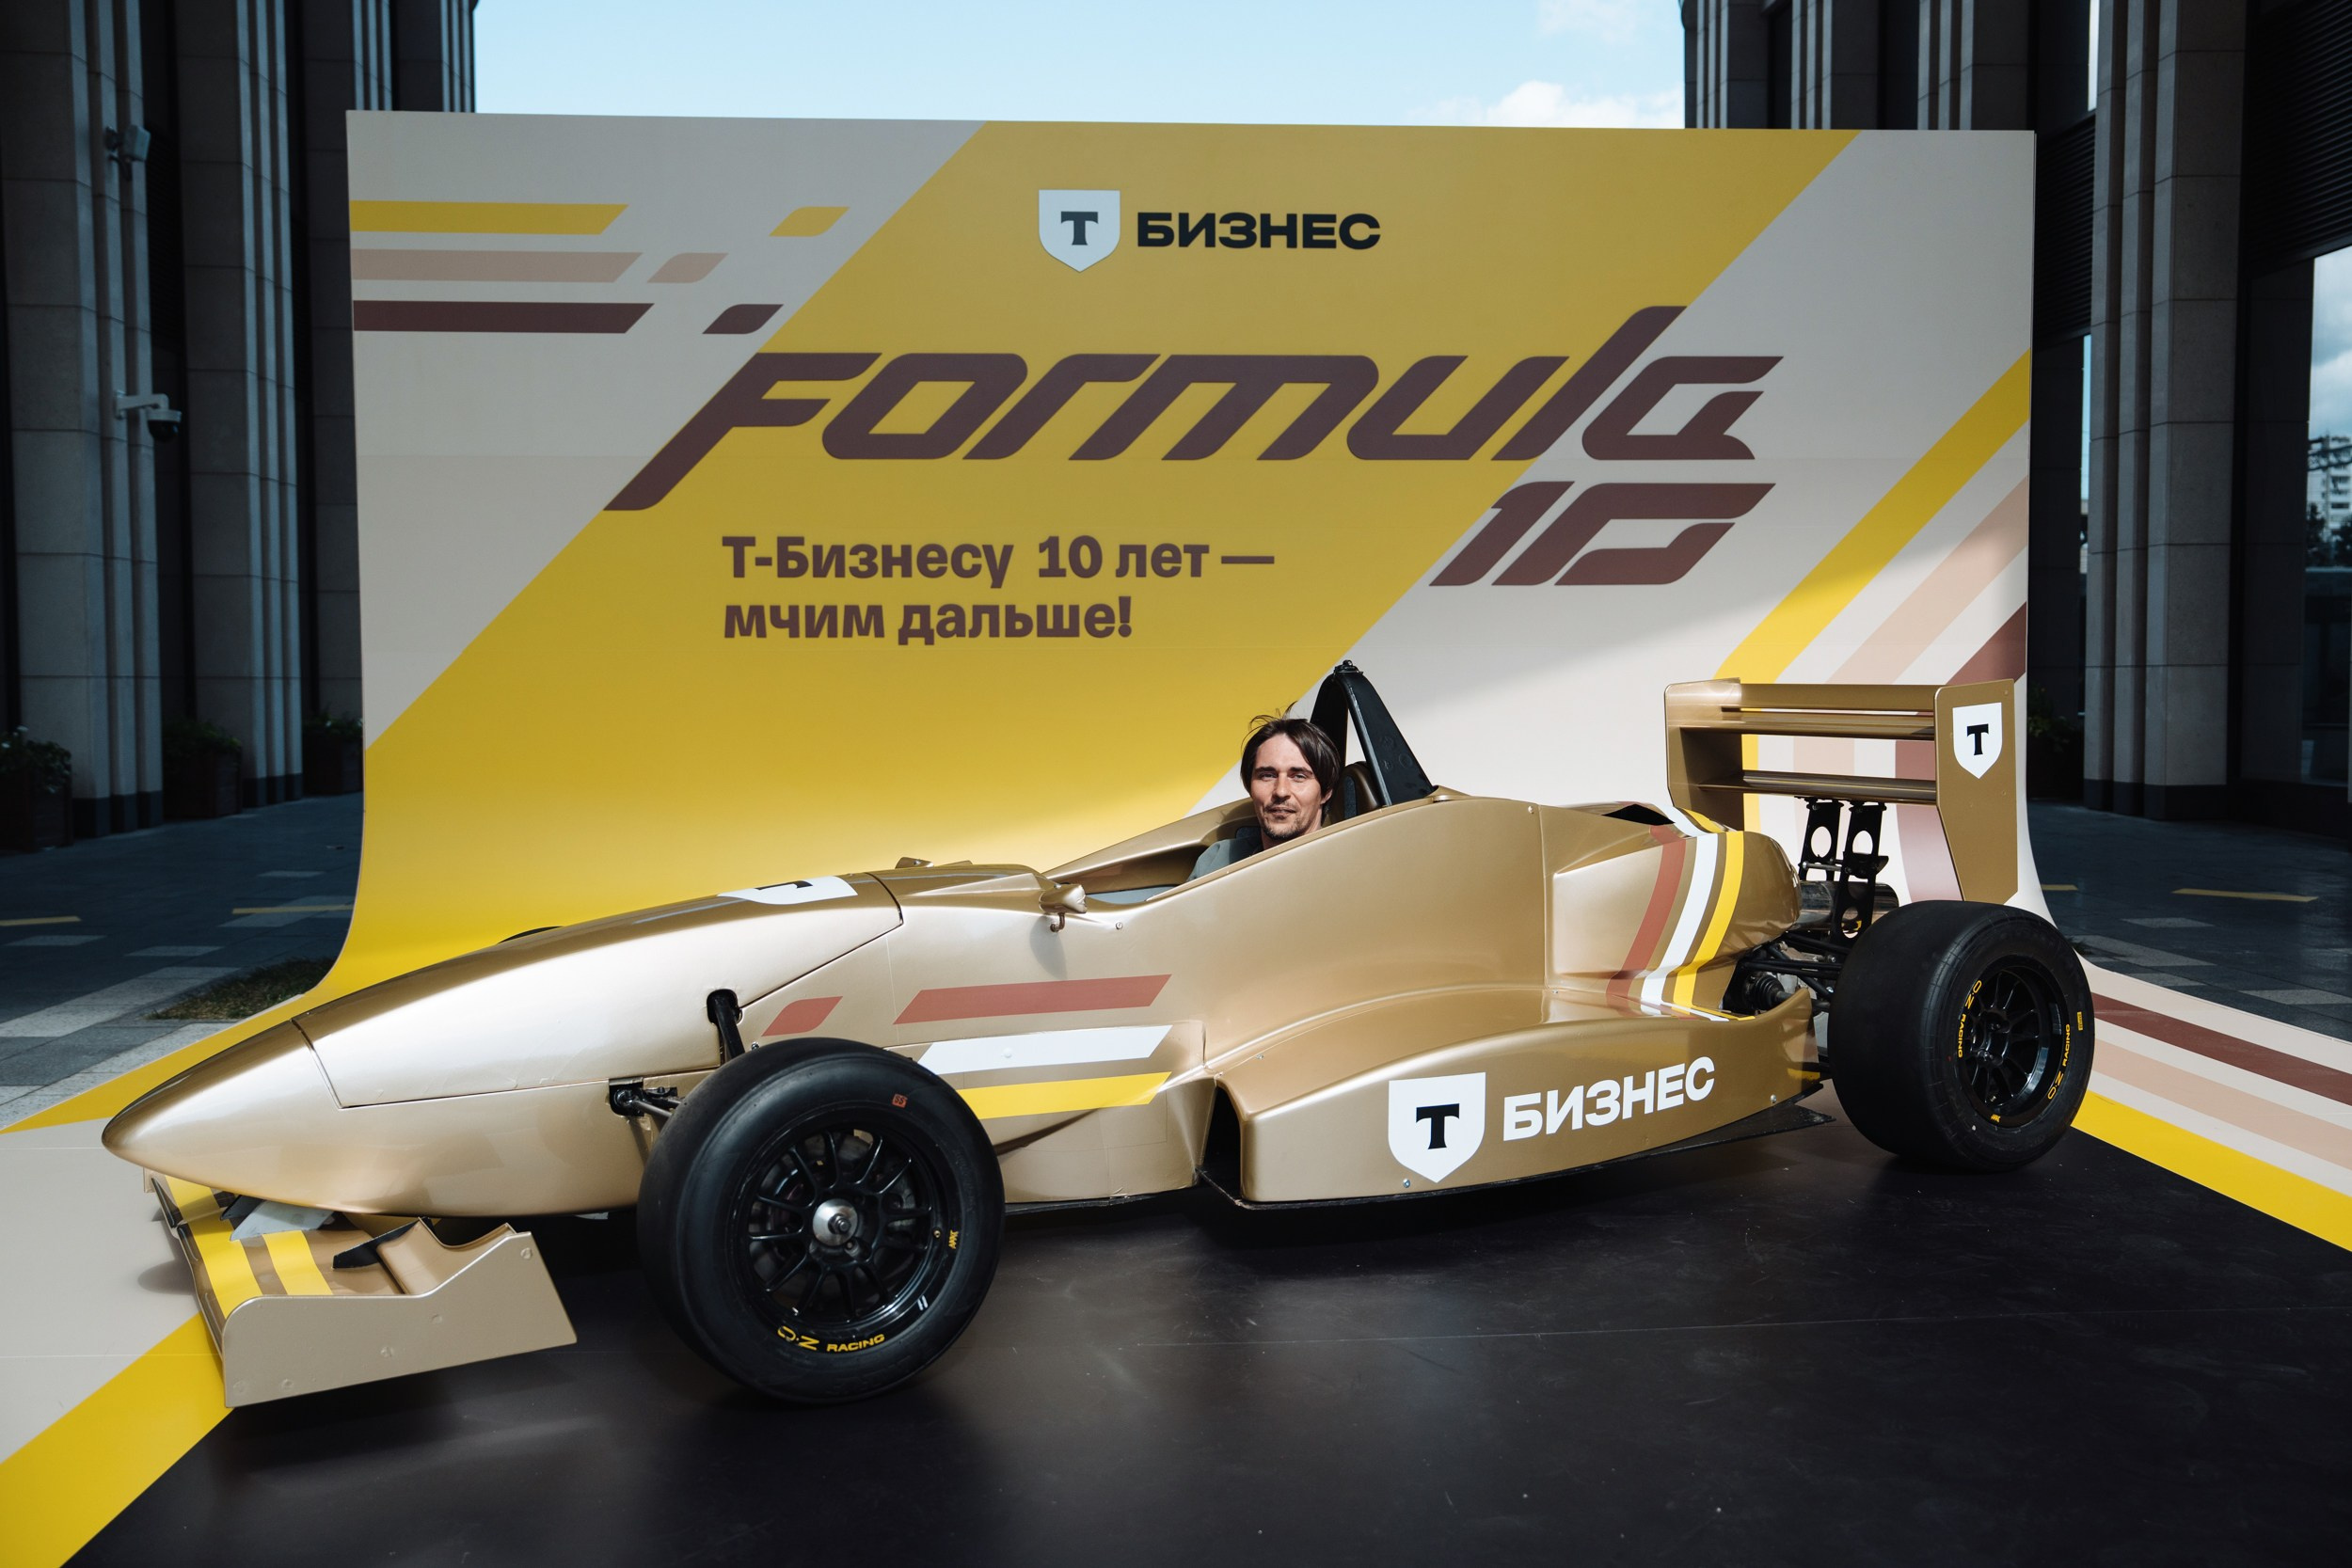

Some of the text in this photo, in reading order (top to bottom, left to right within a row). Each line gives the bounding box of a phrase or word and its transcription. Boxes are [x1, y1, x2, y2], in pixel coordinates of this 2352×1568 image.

[1136, 212, 1381, 250] БИЗНЕС
[602, 305, 1785, 512] Formula
[722, 535, 1014, 589] Т-Бизнесу
[1038, 534, 1104, 579] 10
[1115, 543, 1210, 578] лет
[723, 595, 1132, 646] мчим дальше!
[2061, 1023, 2071, 1067] RACING
[1502, 1056, 1715, 1142] БИЗНЕС
[826, 1334, 885, 1353] RACING
